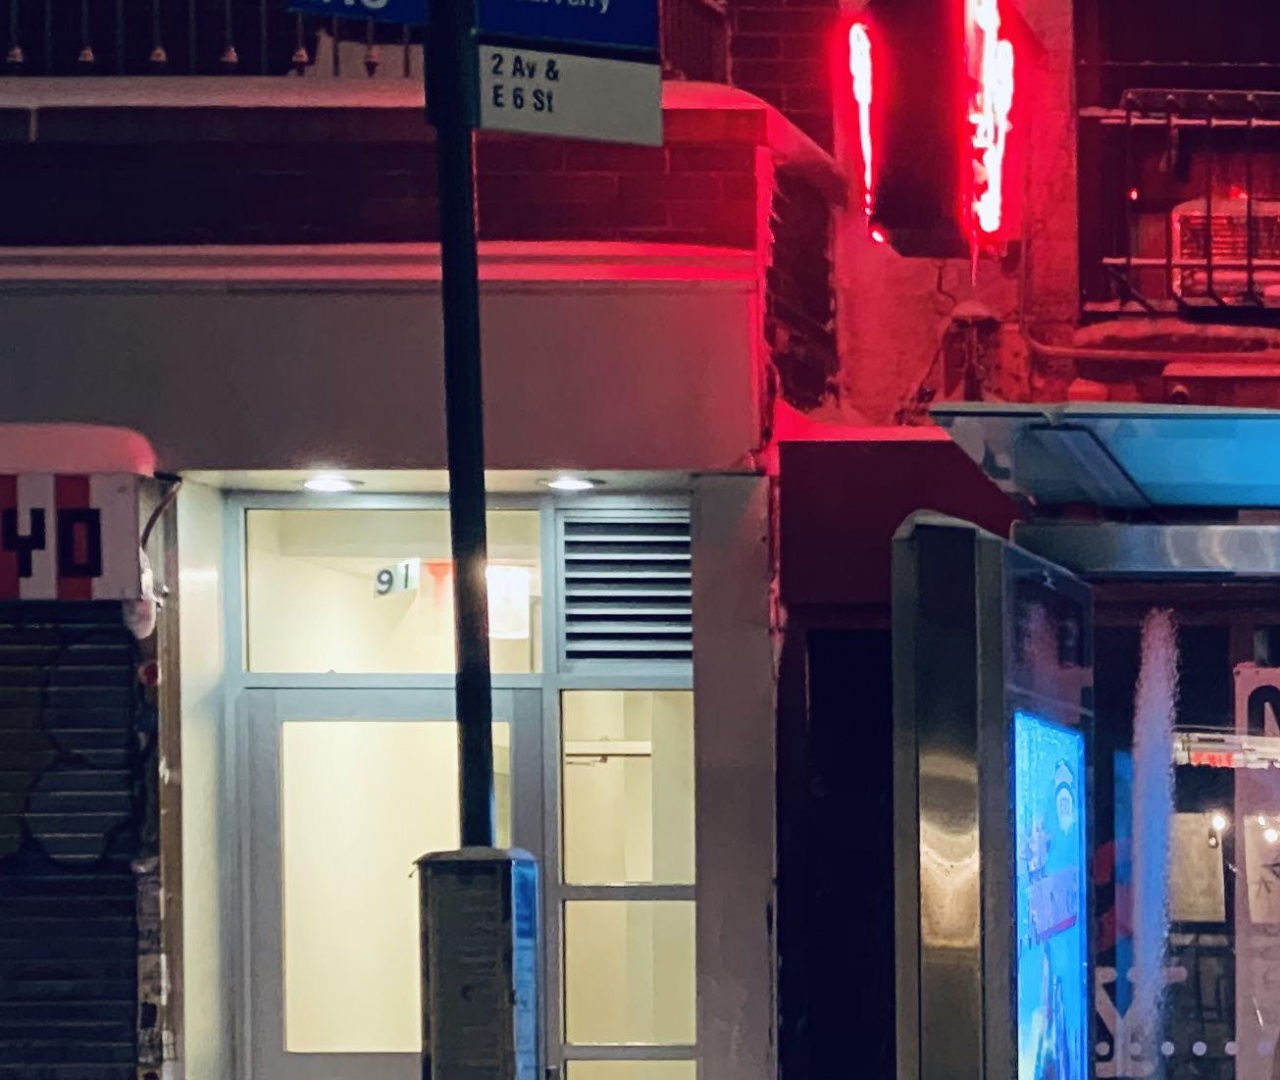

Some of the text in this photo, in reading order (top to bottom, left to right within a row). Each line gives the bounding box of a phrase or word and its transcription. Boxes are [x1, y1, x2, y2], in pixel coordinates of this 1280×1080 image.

[491, 53, 559, 82] 2 Av &
[493, 85, 553, 113] E 6 St
[376, 563, 411, 596] 91
